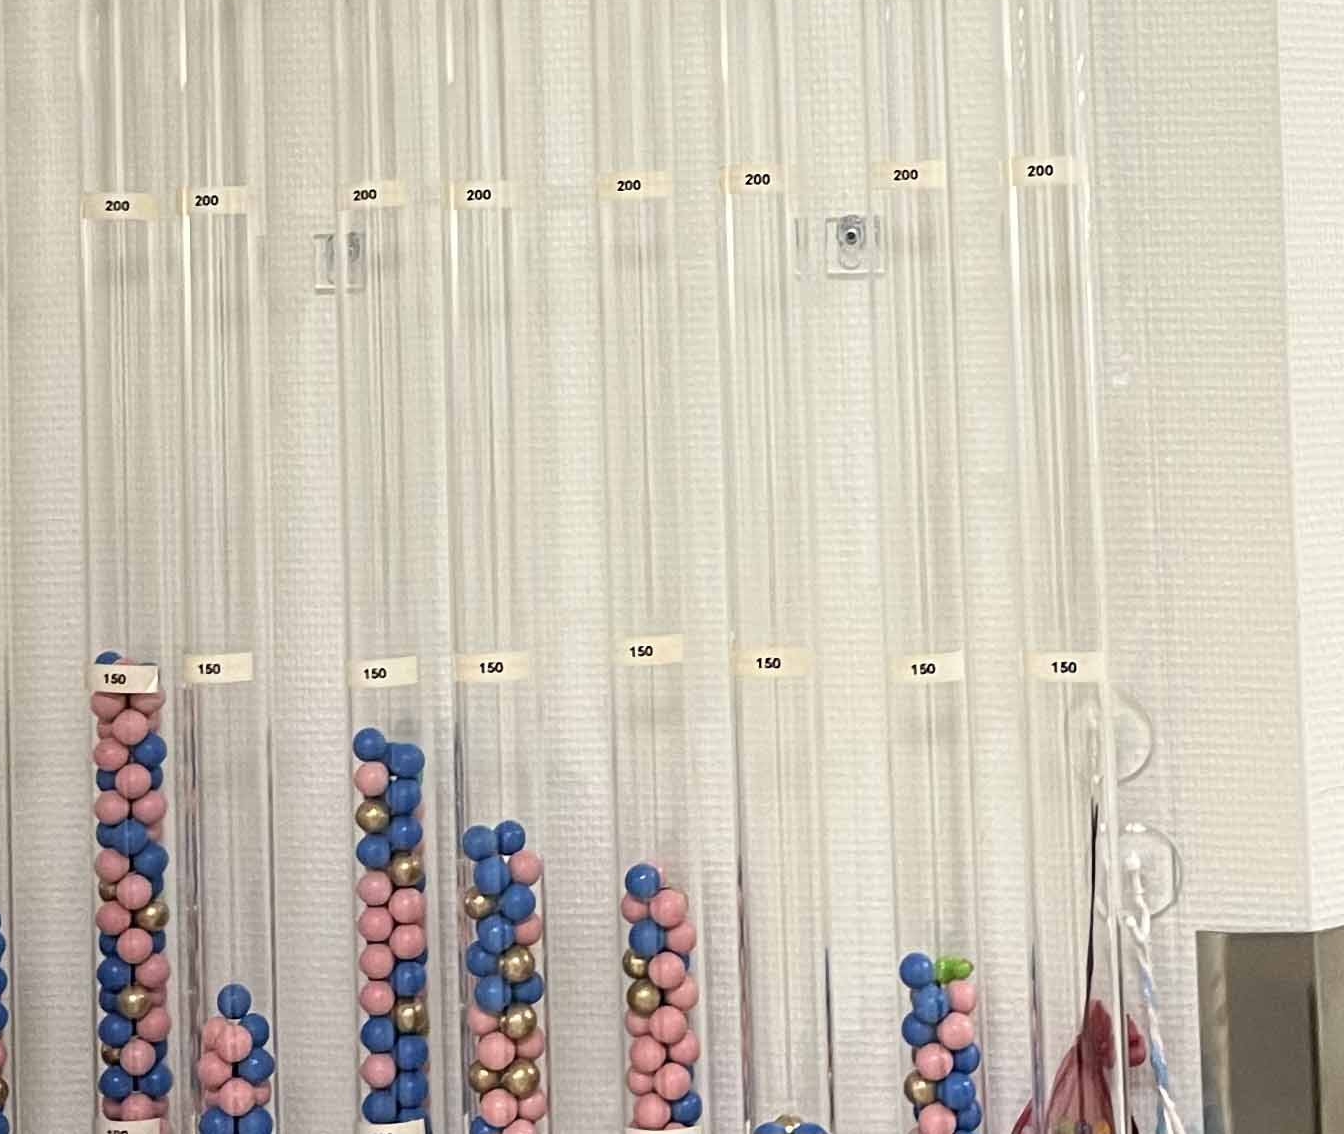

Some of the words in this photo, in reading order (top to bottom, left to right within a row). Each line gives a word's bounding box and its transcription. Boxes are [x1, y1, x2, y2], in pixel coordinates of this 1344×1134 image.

[893, 169, 919, 182] 200
[1026, 164, 1054, 178] 200
[616, 179, 642, 192] 200
[744, 173, 771, 186] 200
[194, 194, 220, 207] 200
[353, 188, 377, 202] 200
[466, 188, 492, 202] 200
[104, 200, 130, 212] 200
[629, 645, 654, 658] 150
[197, 663, 221, 675] 150
[479, 661, 504, 674] 150
[756, 657, 782, 669] 150
[911, 662, 936, 675] 150
[1051, 661, 1078, 674] 150
[103, 673, 127, 685] 150
[363, 667, 388, 680] 150
